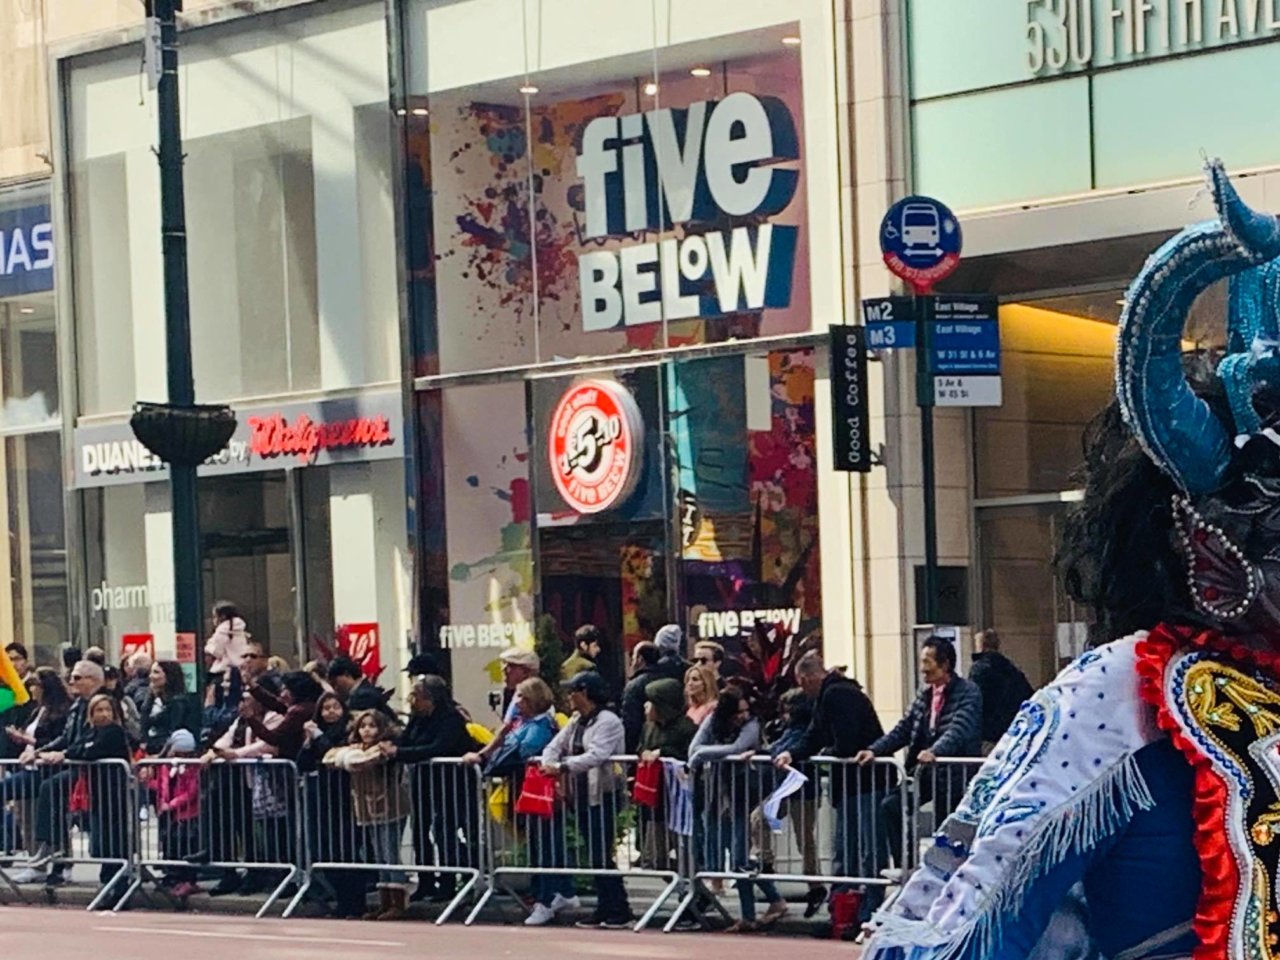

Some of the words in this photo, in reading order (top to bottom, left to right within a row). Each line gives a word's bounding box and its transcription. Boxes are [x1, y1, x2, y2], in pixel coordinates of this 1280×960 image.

[1026, 0, 1092, 74] 530
[576, 92, 773, 239] five
[0, 222, 54, 275] AS
[867, 302, 893, 321] M2
[953, 303, 978, 313] Village
[870, 326, 896, 345] M3
[955, 325, 982, 335] Village
[845, 334, 859, 406] Coffee
[82, 439, 152, 472] DUANE
[247, 412, 391, 464] Walgreens
[848, 417, 861, 463] Good
[439, 625, 476, 649] five
[698, 610, 739, 638] five
